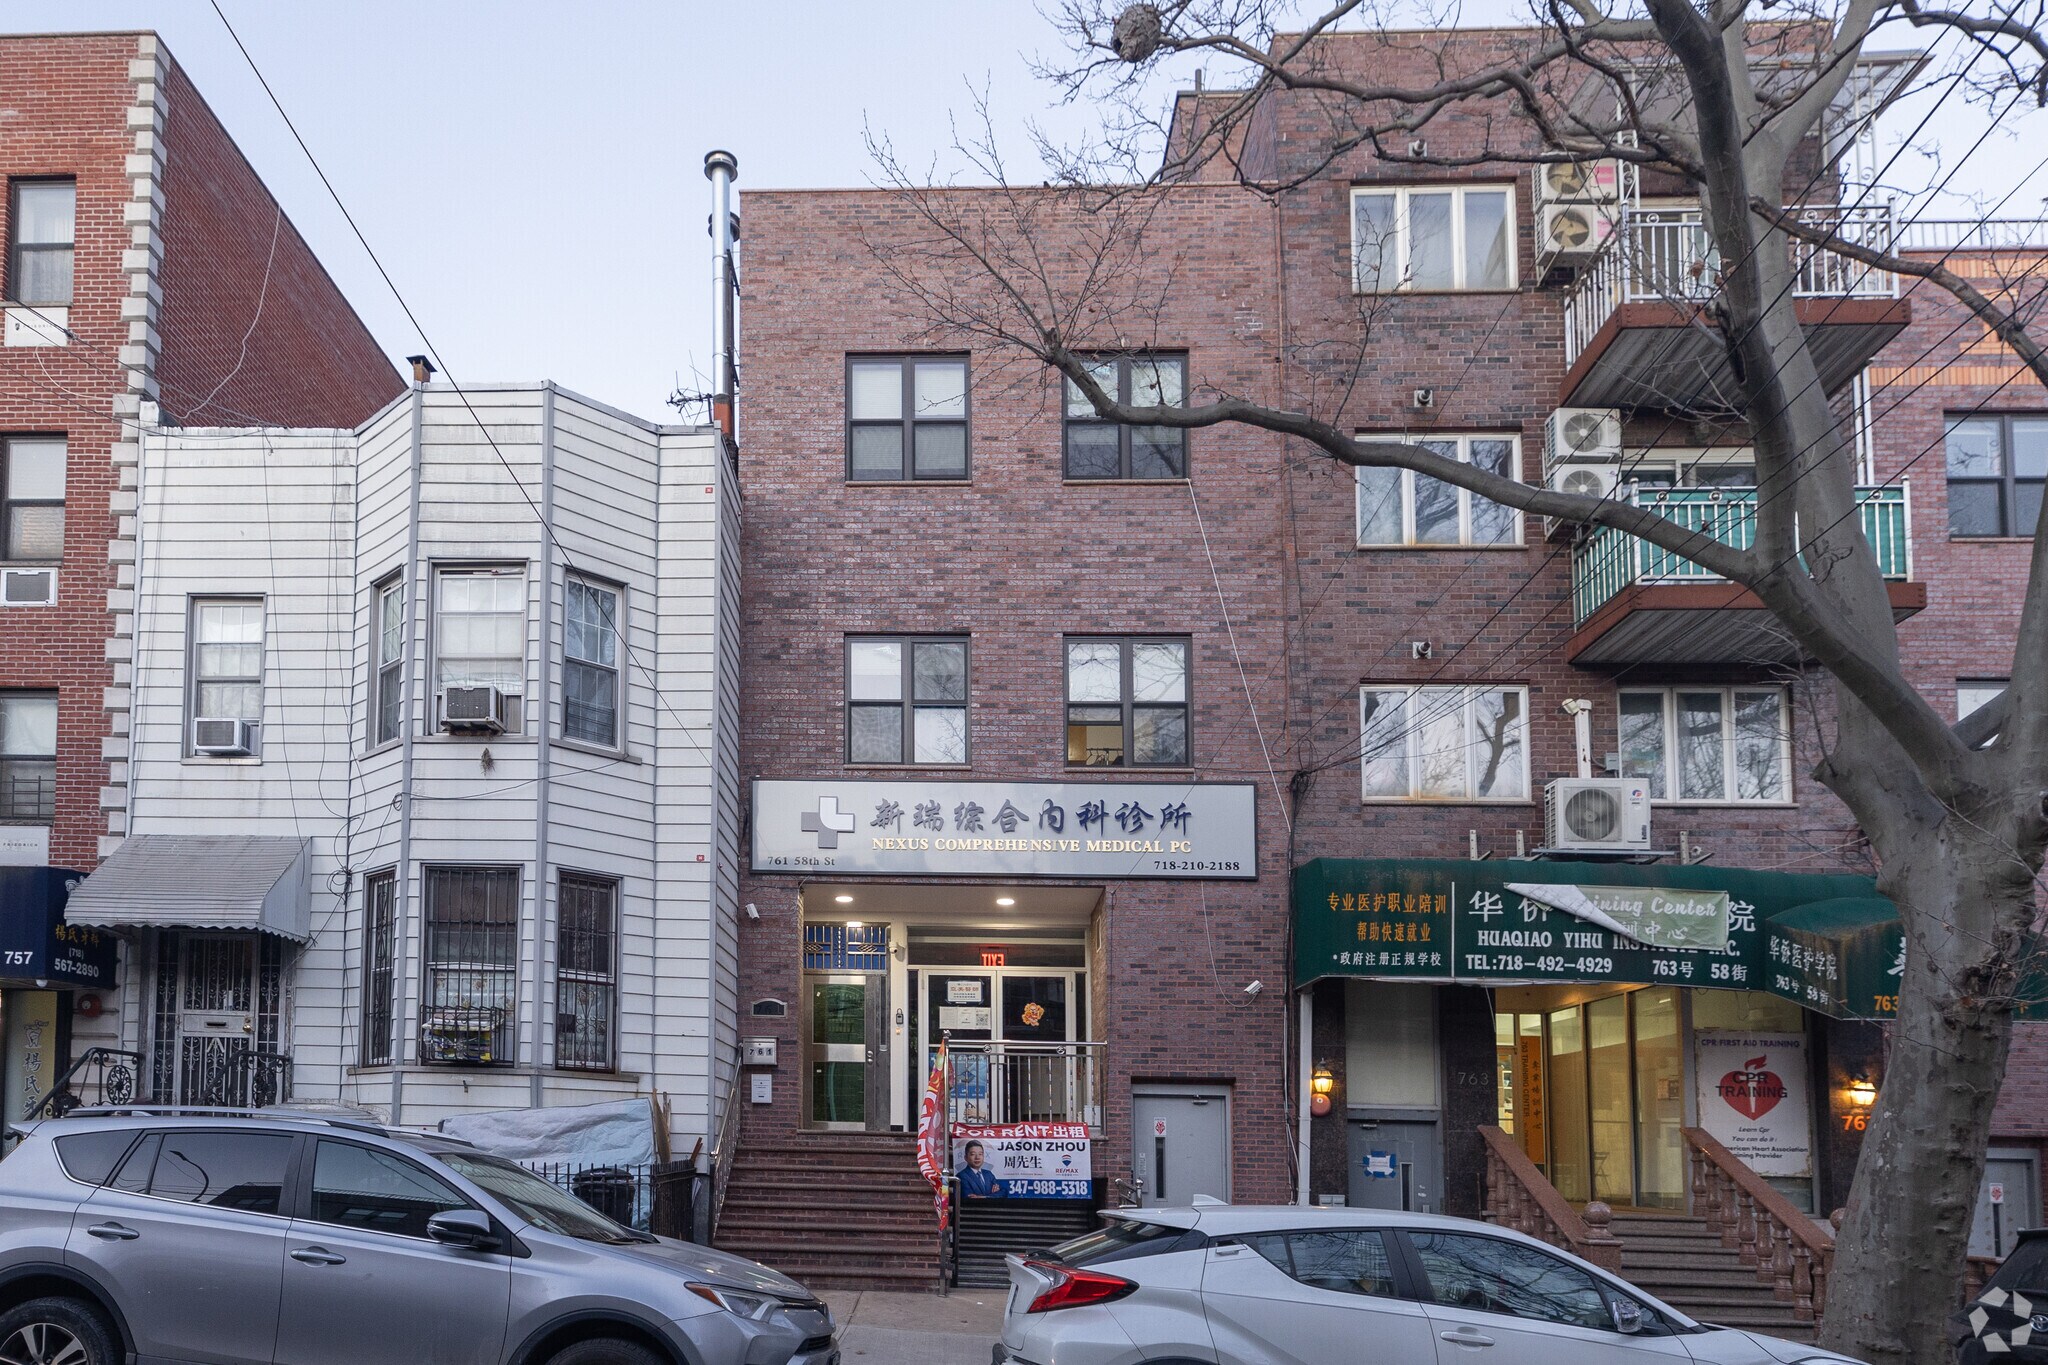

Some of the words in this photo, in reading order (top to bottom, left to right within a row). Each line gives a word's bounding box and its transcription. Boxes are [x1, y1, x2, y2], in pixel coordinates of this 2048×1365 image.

[870, 798, 1193, 837] 新瑞综合内科诊所
[872, 837, 929, 851] NEXUS
[934, 838, 1080, 853] COMPREHENSIVE
[1086, 840, 1164, 853] MEDICAL
[1169, 840, 1192, 854] PC
[767, 856, 789, 866] 761
[793, 856, 820, 866] 58th
[823, 857, 836, 866] St
[1154, 860, 1240, 871] 718-210-2188
[1594, 895, 1643, 917] ining
[1651, 896, 1717, 917] Center
[1357, 921, 1431, 942] 帮助快速就业
[1477, 930, 1553, 948] HUAQIAO
[1563, 932, 1603, 949] YIHU
[4, 951, 33, 965] 757
[68, 947, 84, 960] (718)
[1340, 951, 1442, 967] 政府注册正规学校
[54, 958, 99, 978] 567-2890
[1652, 959, 1695, 979] 763号
[1710, 963, 1747, 982] 58街
[1701, 1039, 1717, 1047] CPR
[1719, 1039, 1741, 1047] FIRST
[1760, 1040, 1800, 1048] TRAINING
[749, 1047, 773, 1056] 761
[1457, 1071, 1489, 1086] 763
[1732, 1071, 1768, 1084] CPR
[1715, 1085, 1788, 1098] TRAINING
[1841, 1115, 1872, 1131] 76
[956, 1125, 995, 1137] FOR
[1001, 1124, 1049, 1137] RENT
[1053, 1126, 1086, 1138] 出租
[997, 1141, 1042, 1152] JASON
[1045, 1141, 1086, 1152] ZHOU
[1003, 1155, 1043, 1169] 周先生
[1009, 1180, 1088, 1195] 347-988-5318
